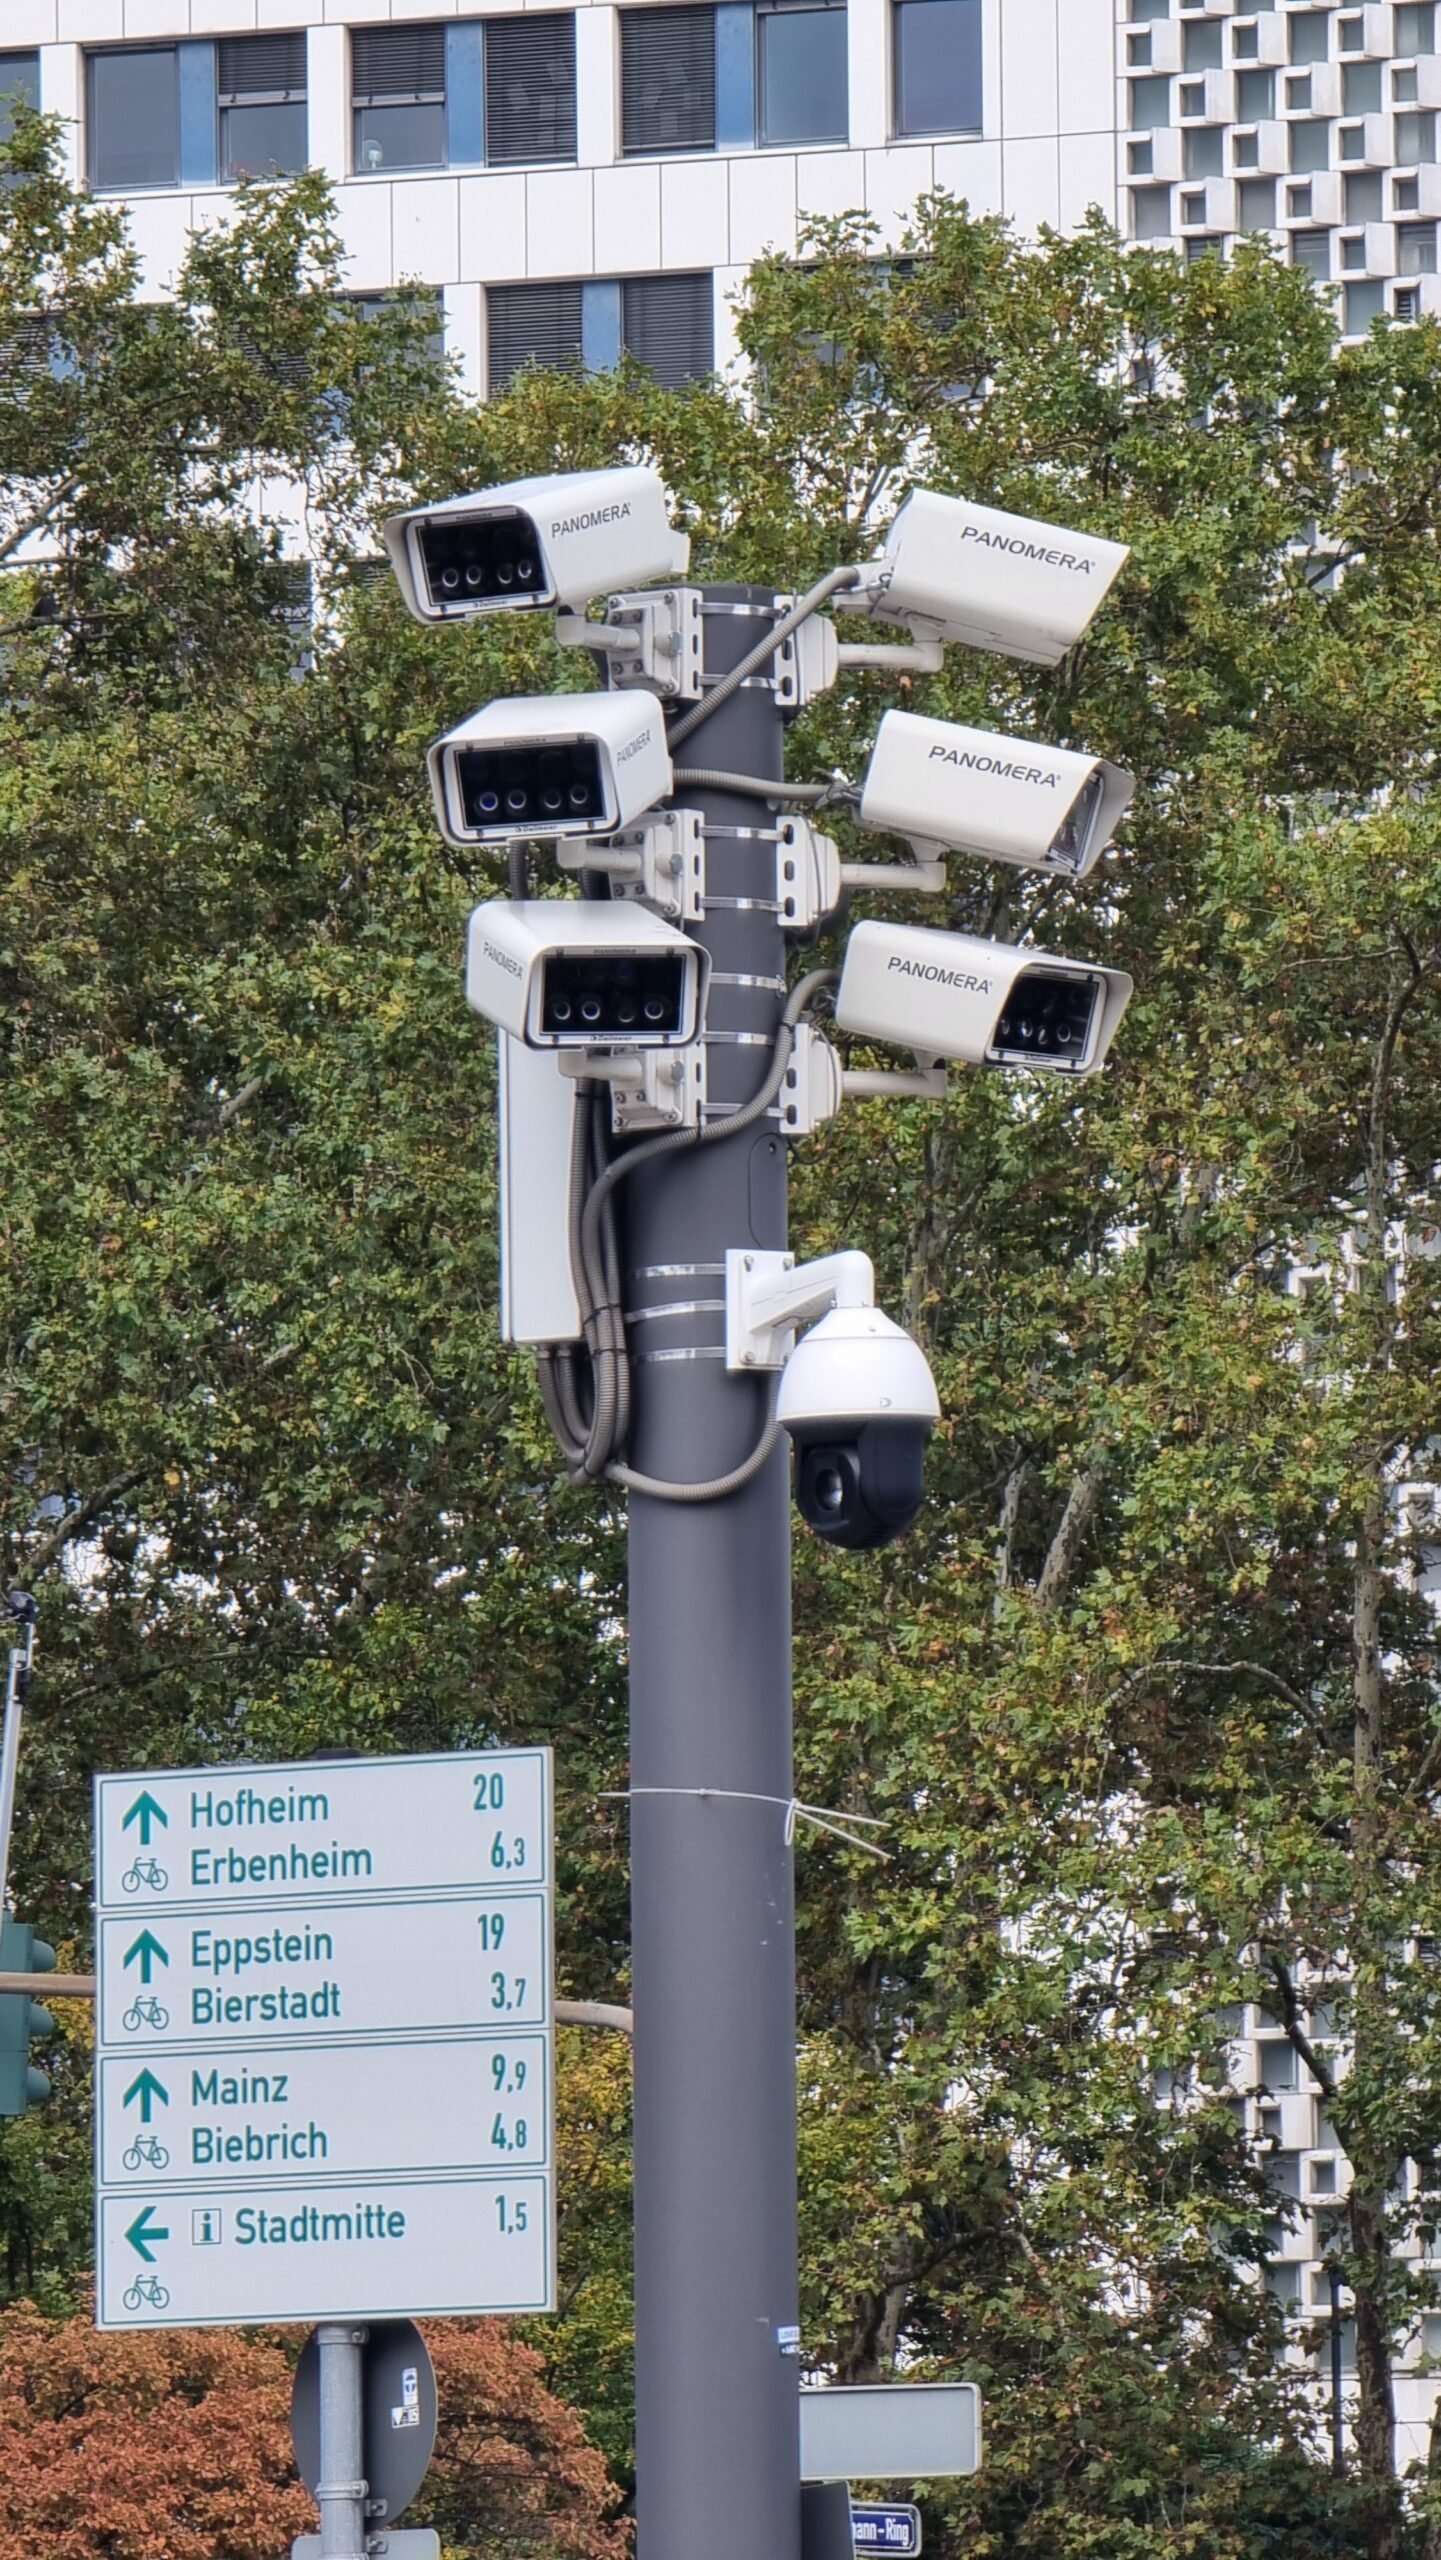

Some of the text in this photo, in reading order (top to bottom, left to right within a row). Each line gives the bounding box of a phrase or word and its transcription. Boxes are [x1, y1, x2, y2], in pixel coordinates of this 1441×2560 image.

[191, 1772, 505, 1829] Hofheim 20
[191, 1831, 525, 1886] Erbenheim 6,3
[191, 1913, 505, 1976] Eppstein 19
[191, 1971, 526, 2025] Bierstadt 3,7
[191, 2053, 527, 2107] Mainz 9,9
[192, 2112, 527, 2165] Biebrich 4,8
[235, 2202, 406, 2245] Stadtmitte
[495, 2194, 527, 2234] 1,5
